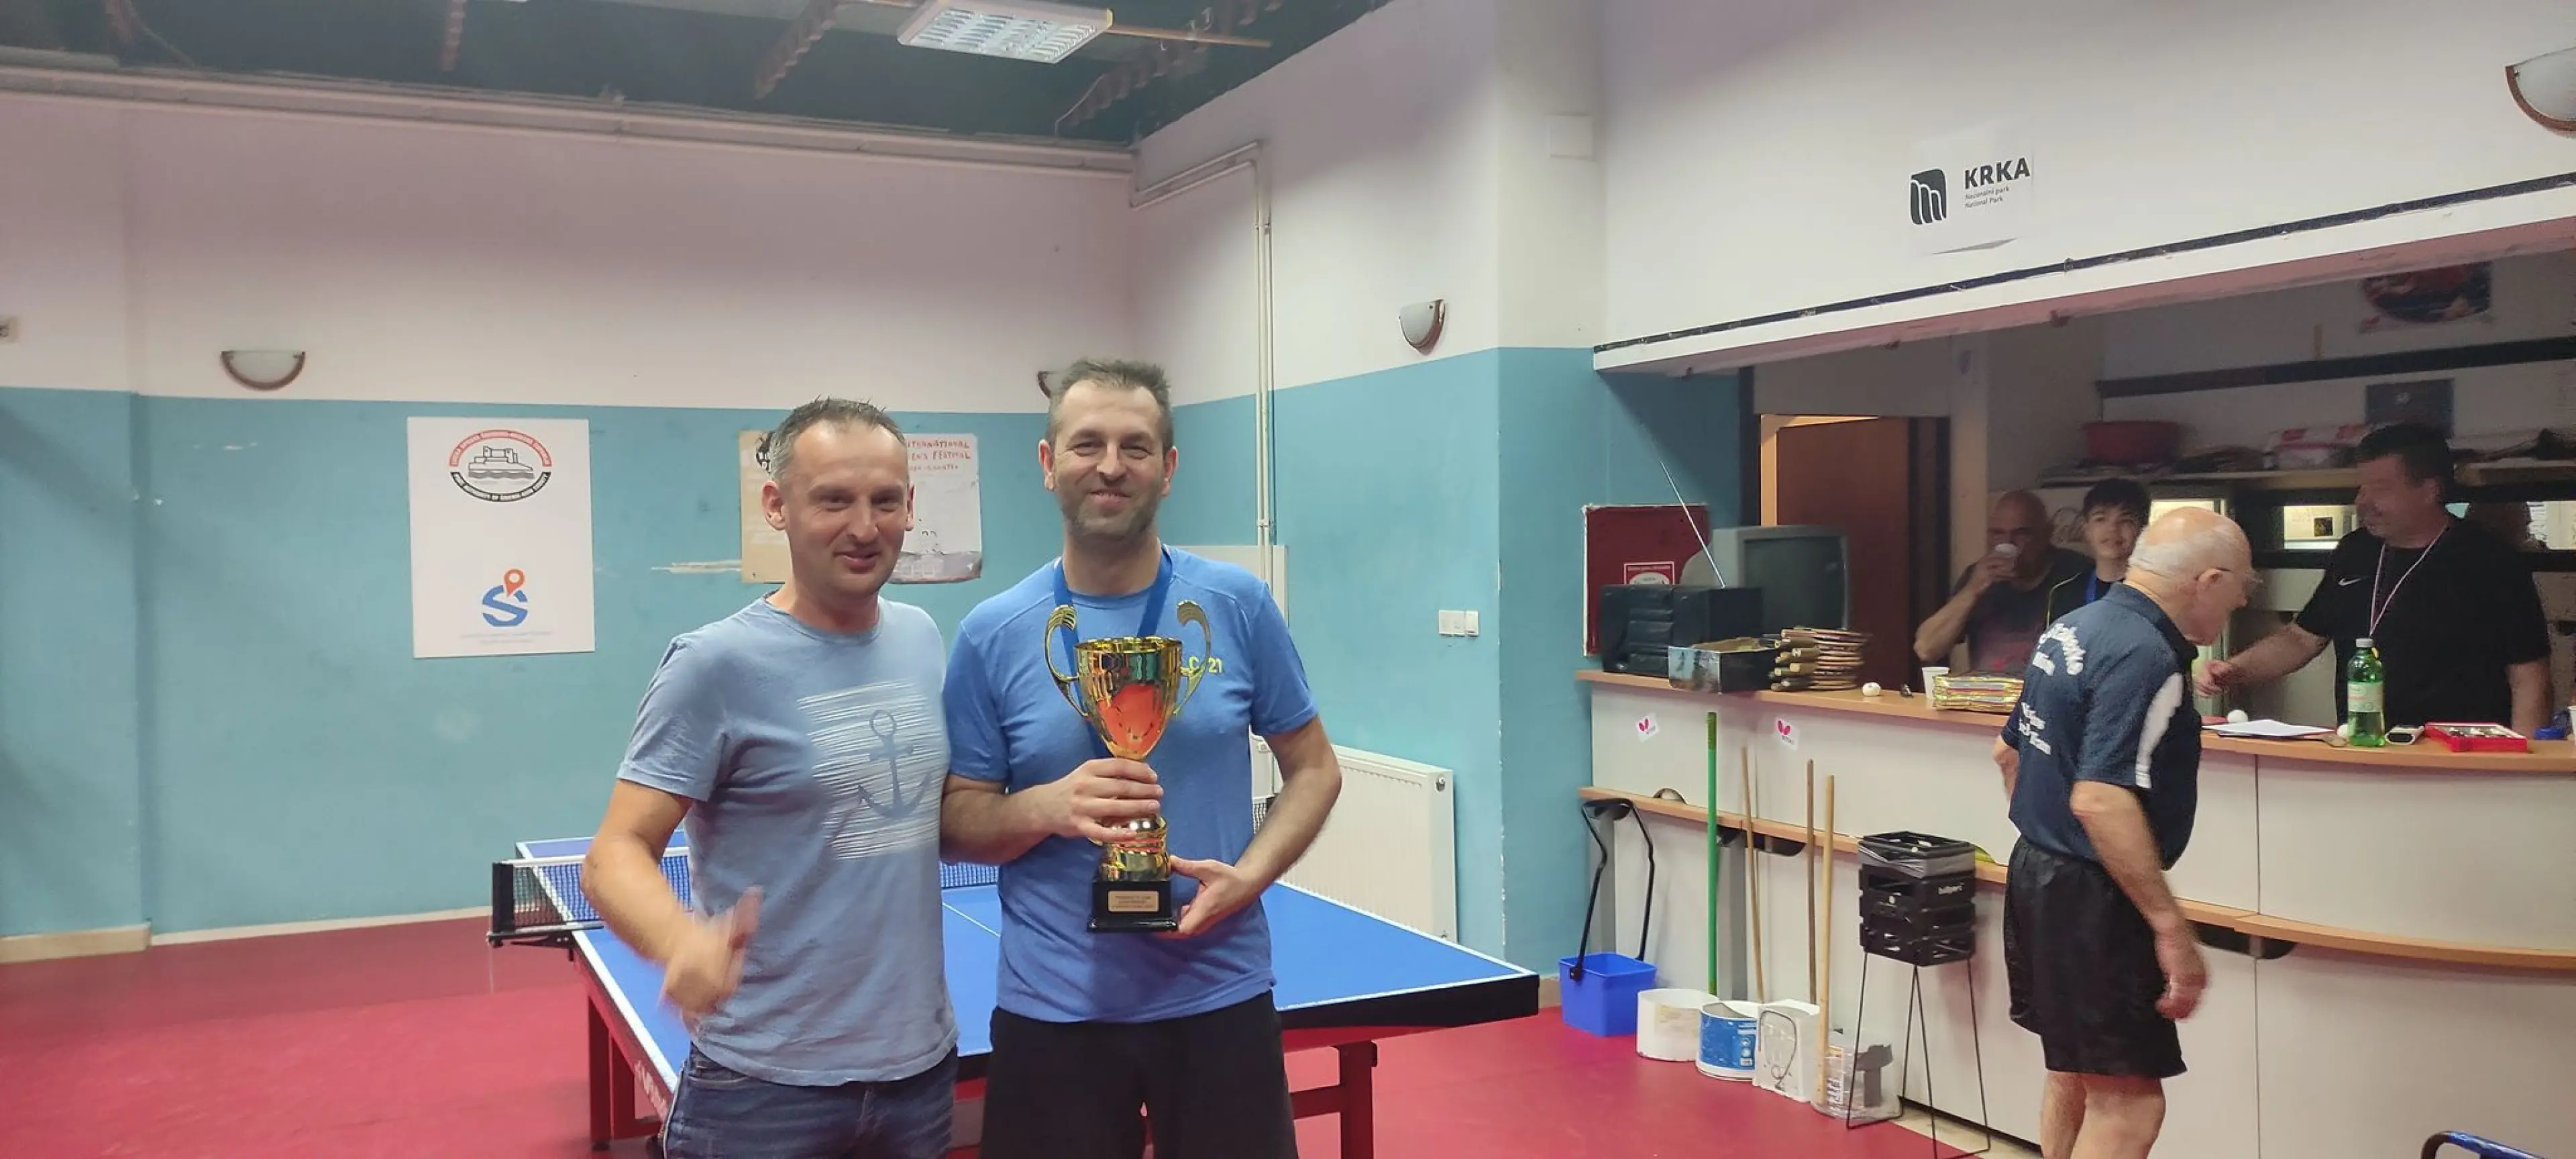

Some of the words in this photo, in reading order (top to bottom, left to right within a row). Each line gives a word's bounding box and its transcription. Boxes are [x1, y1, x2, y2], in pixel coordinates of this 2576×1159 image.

[1964, 156, 2031, 189] KRKA
[1996, 186, 2009, 195] park
[1989, 196, 2003, 204] Park
